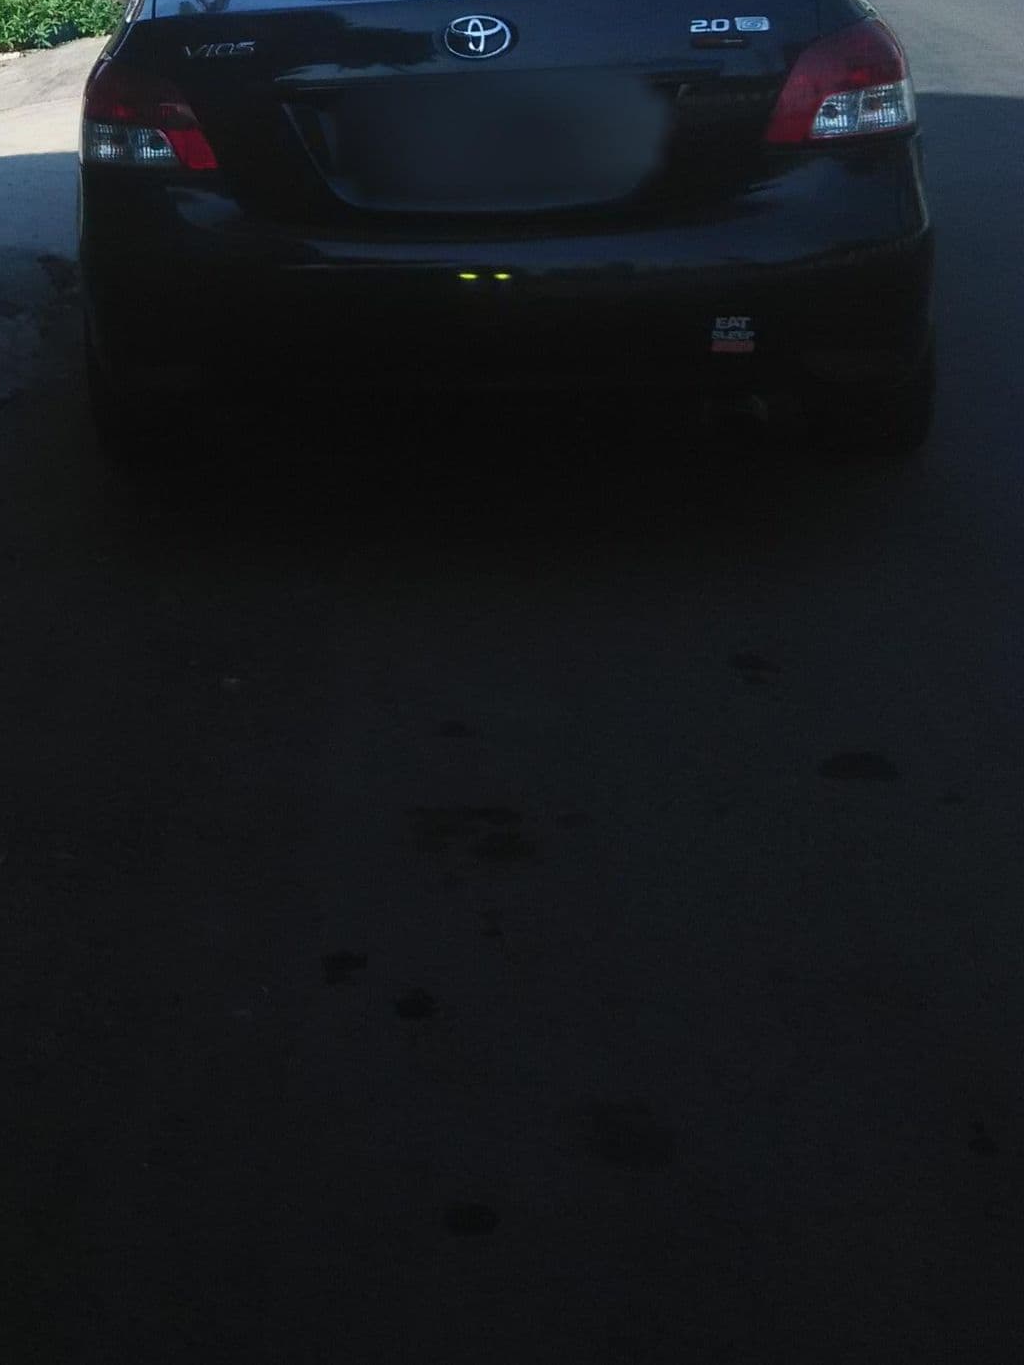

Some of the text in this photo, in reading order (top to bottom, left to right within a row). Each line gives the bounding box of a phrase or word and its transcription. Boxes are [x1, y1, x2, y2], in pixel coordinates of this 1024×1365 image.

[690, 18, 730, 33] 2.0
[184, 40, 256, 57] VIOS
[715, 316, 751, 330] EAT
